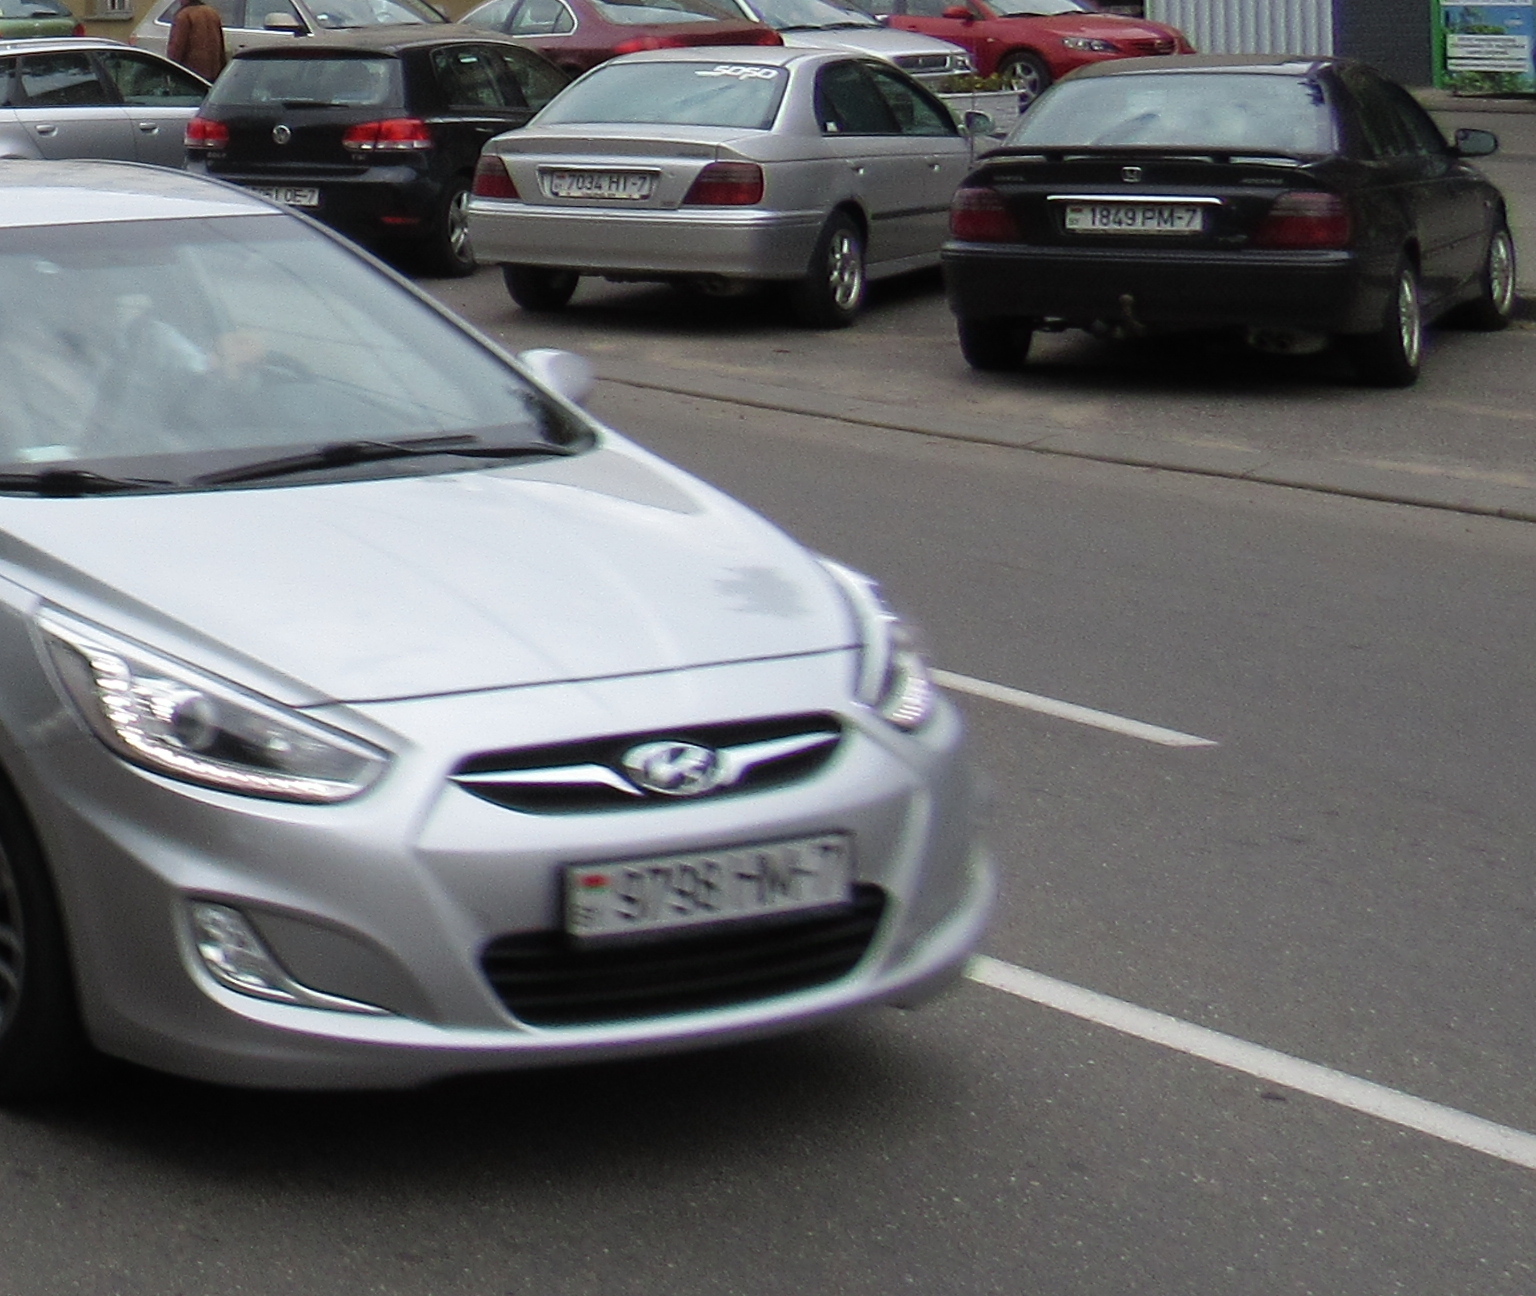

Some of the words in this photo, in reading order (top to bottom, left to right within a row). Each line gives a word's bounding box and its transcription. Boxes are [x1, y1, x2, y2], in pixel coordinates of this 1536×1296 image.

[567, 174, 602, 190] 7034
[1091, 207, 1136, 227] 1849
[1141, 207, 1197, 227] PM-7
